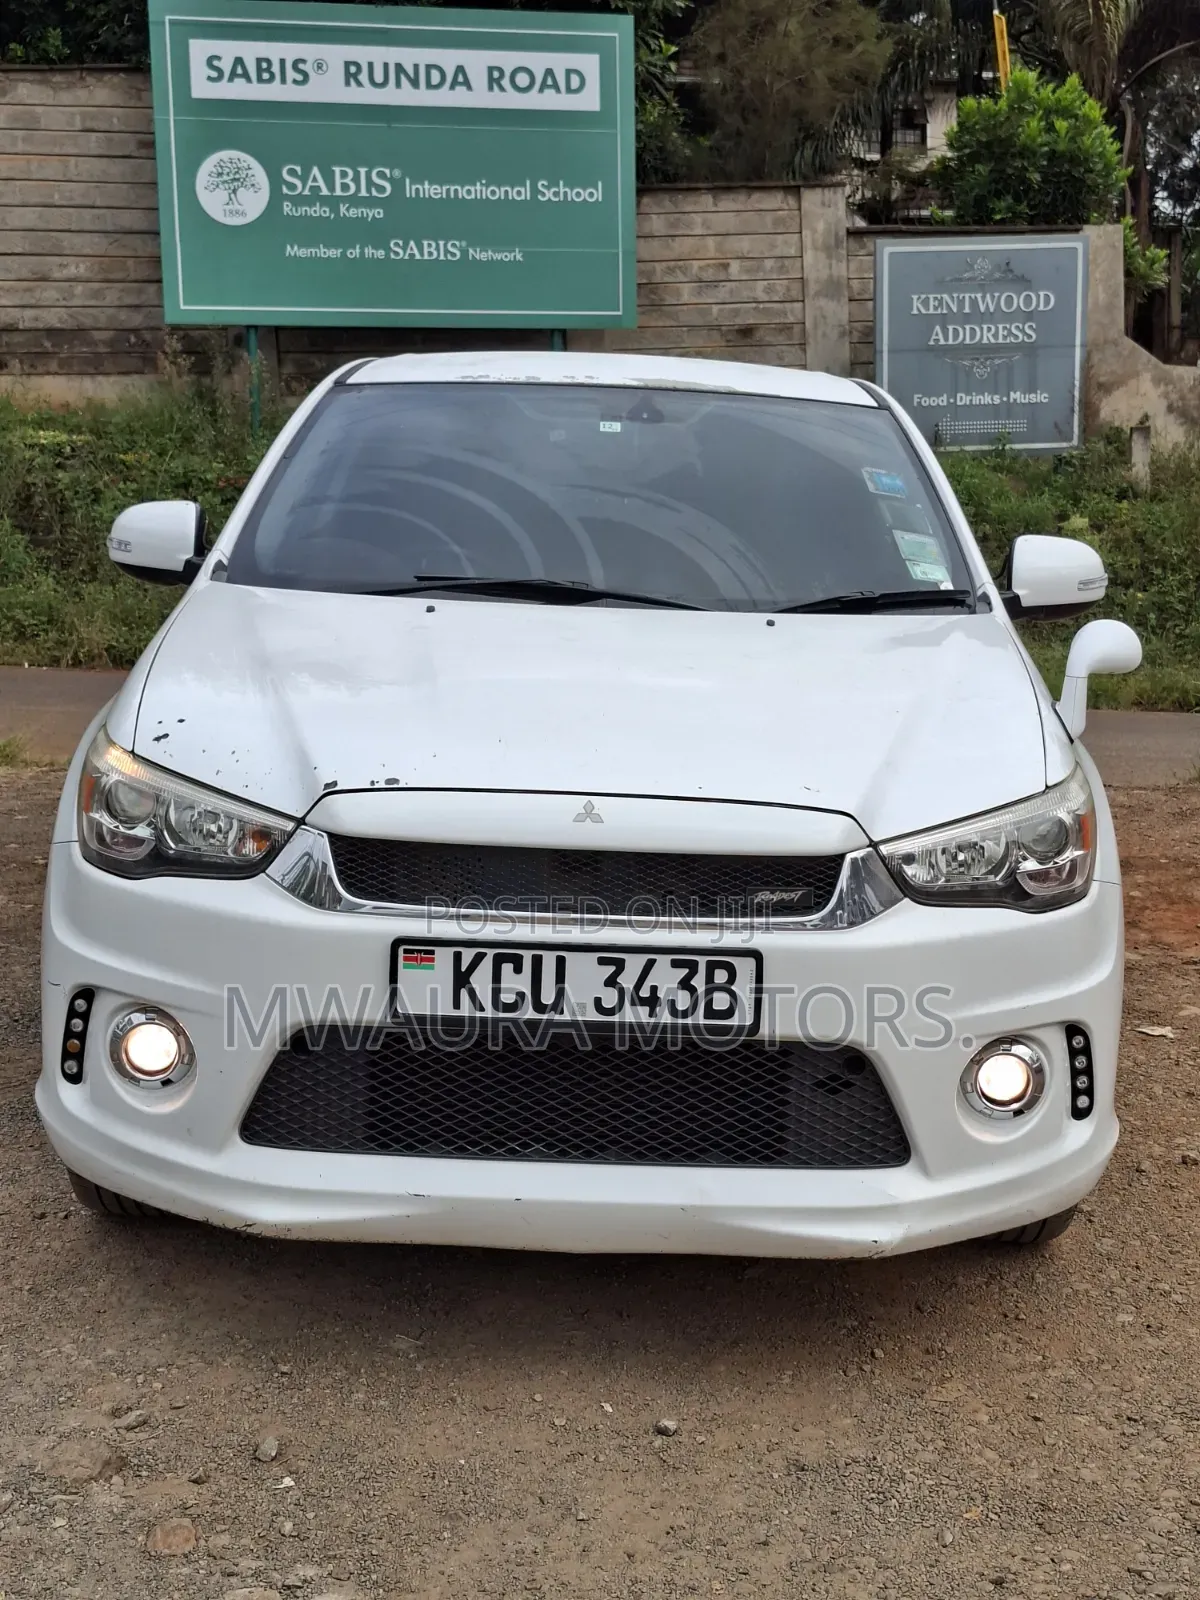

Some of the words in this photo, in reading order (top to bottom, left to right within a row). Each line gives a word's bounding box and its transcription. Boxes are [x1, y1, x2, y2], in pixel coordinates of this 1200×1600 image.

[343, 60, 473, 93] RUNDA
[487, 66, 586, 96] ROAD
[405, 177, 531, 201] International
[537, 180, 603, 203] School
[222, 207, 248, 219] 1886
[283, 201, 335, 220] Runda,
[339, 203, 384, 221] Kenya
[285, 244, 343, 259] Member
[346, 244, 361, 259] of
[364, 246, 386, 259] the
[468, 247, 524, 262] Network
[911, 291, 1055, 315] KENTWOOD
[928, 322, 1037, 345] ADDRESS
[913, 394, 947, 407] Food
[956, 392, 1001, 406] Drinks
[1009, 390, 1049, 404] Music
[452, 950, 567, 1016] KCU
[593, 956, 738, 1021] 343B
